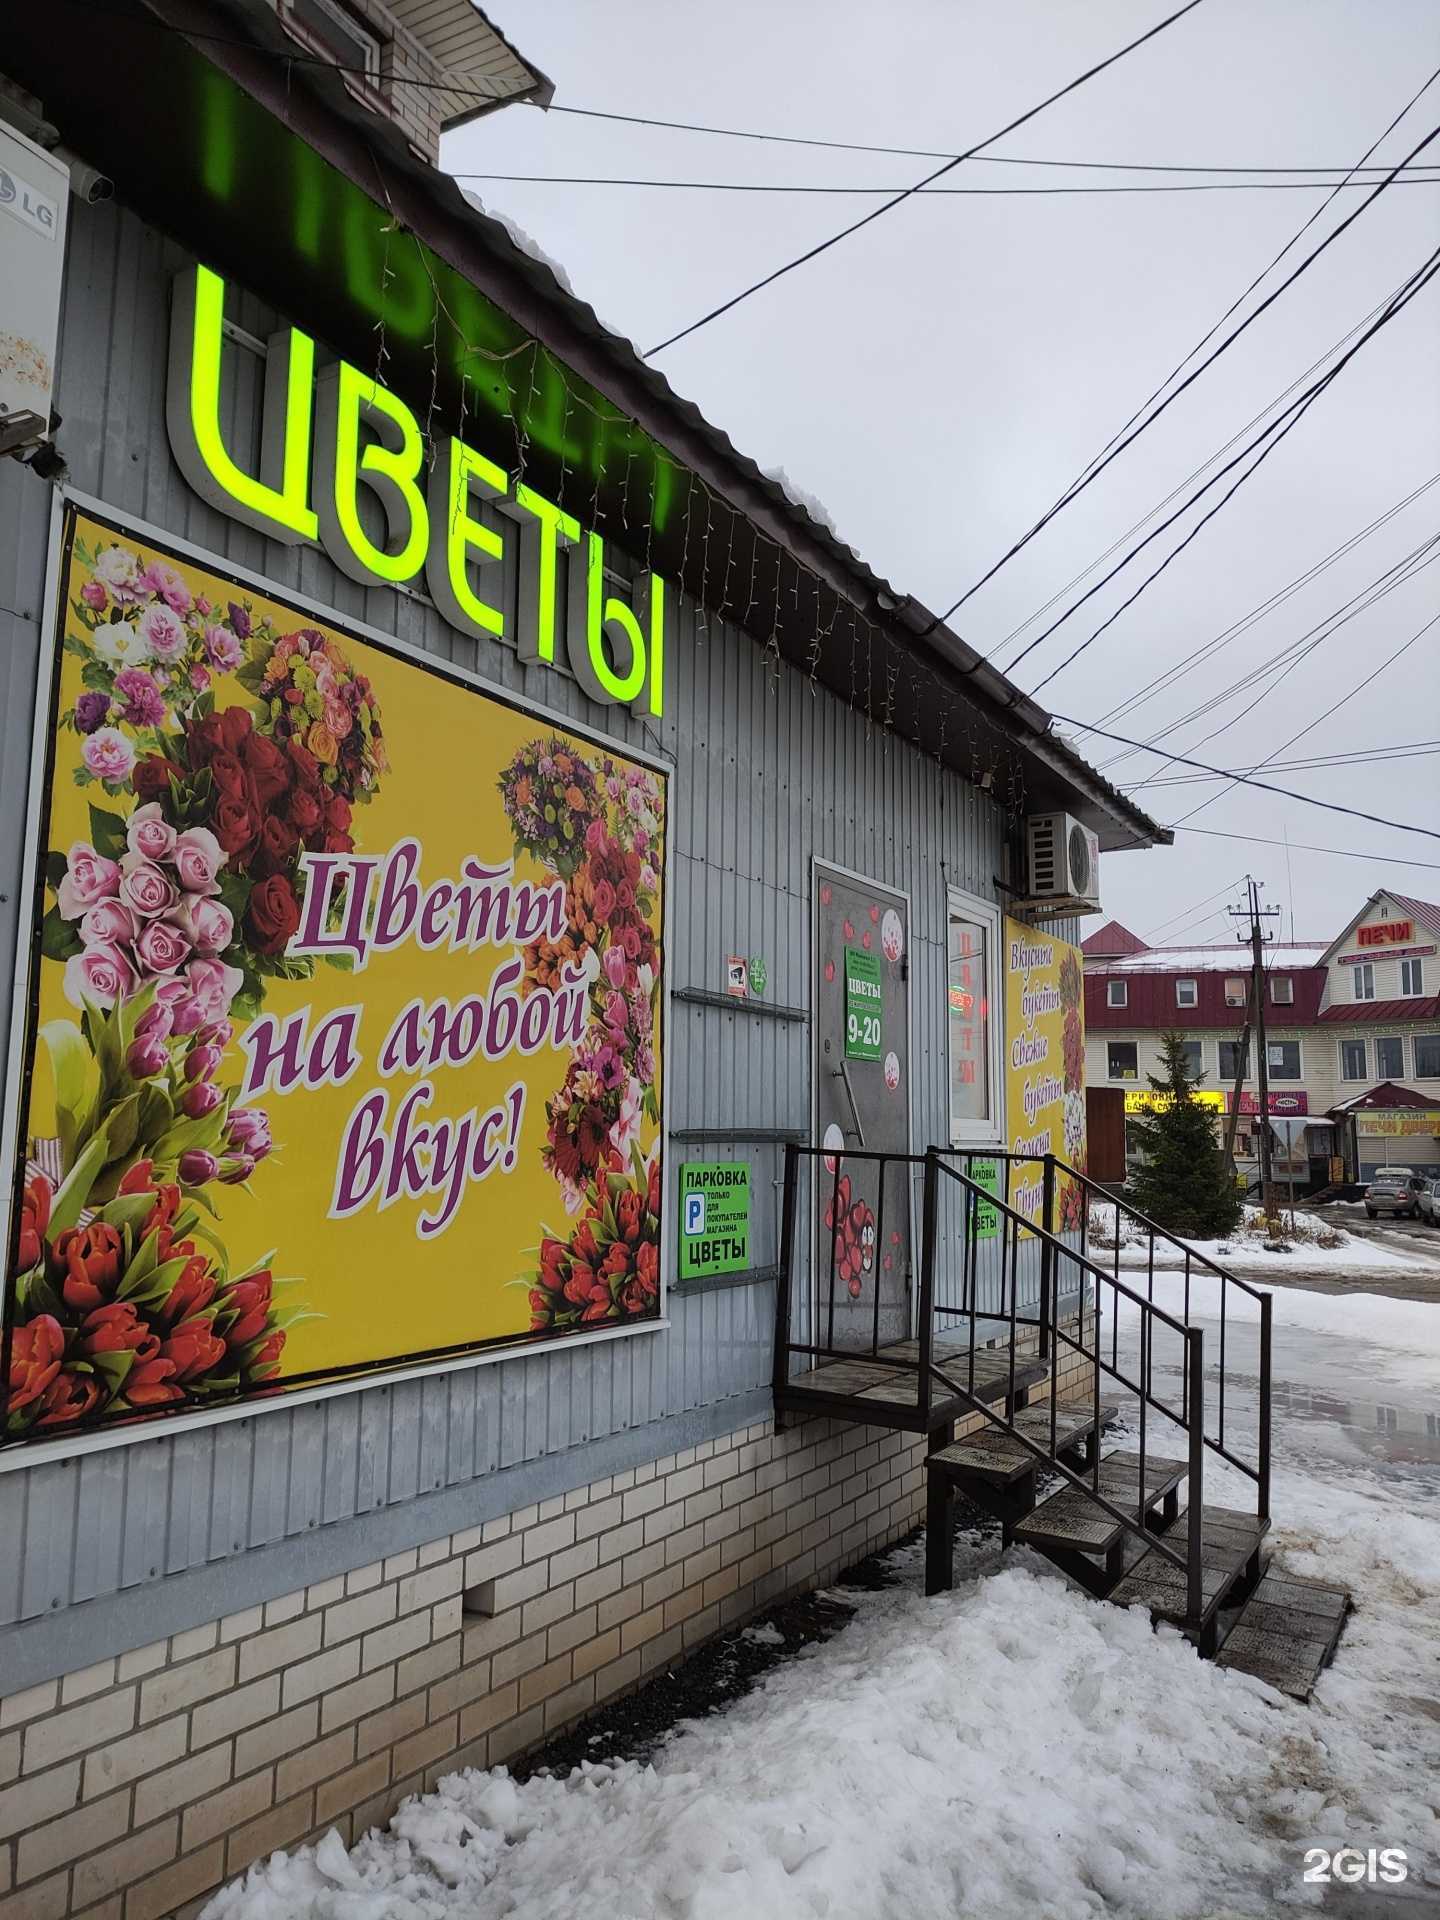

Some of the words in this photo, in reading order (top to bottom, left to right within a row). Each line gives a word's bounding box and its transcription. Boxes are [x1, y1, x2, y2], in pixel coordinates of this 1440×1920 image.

[22, 191, 54, 228] LG
[168, 263, 664, 719] ЦВЕТЫ
[294, 840, 566, 967] Цветы
[1357, 922, 1411, 946] ПЕЧИ
[1011, 938, 1053, 981] Вкусные
[848, 978, 881, 998] ЦВЕТЫ
[1022, 983, 1060, 1028] букеты
[246, 1013, 356, 1095] на
[383, 962, 588, 1070] любой
[848, 1013, 881, 1047] 9-20
[1012, 1031, 1048, 1068] Свежие
[1022, 1075, 1063, 1125] букеты
[1377, 1113, 1426, 1121] МАГАЗИН
[336, 1086, 525, 1234] вкус!
[971, 1168, 996, 1180] АРКОВКА
[686, 1170, 747, 1188] ПАРКОВКА
[706, 1191, 730, 1200] ТОЛЬКО
[706, 1203, 719, 1212] ДЛЯ
[706, 1223, 738, 1234] МАГАЗИНА
[689, 1237, 746, 1269] ЦВЕТЫ
